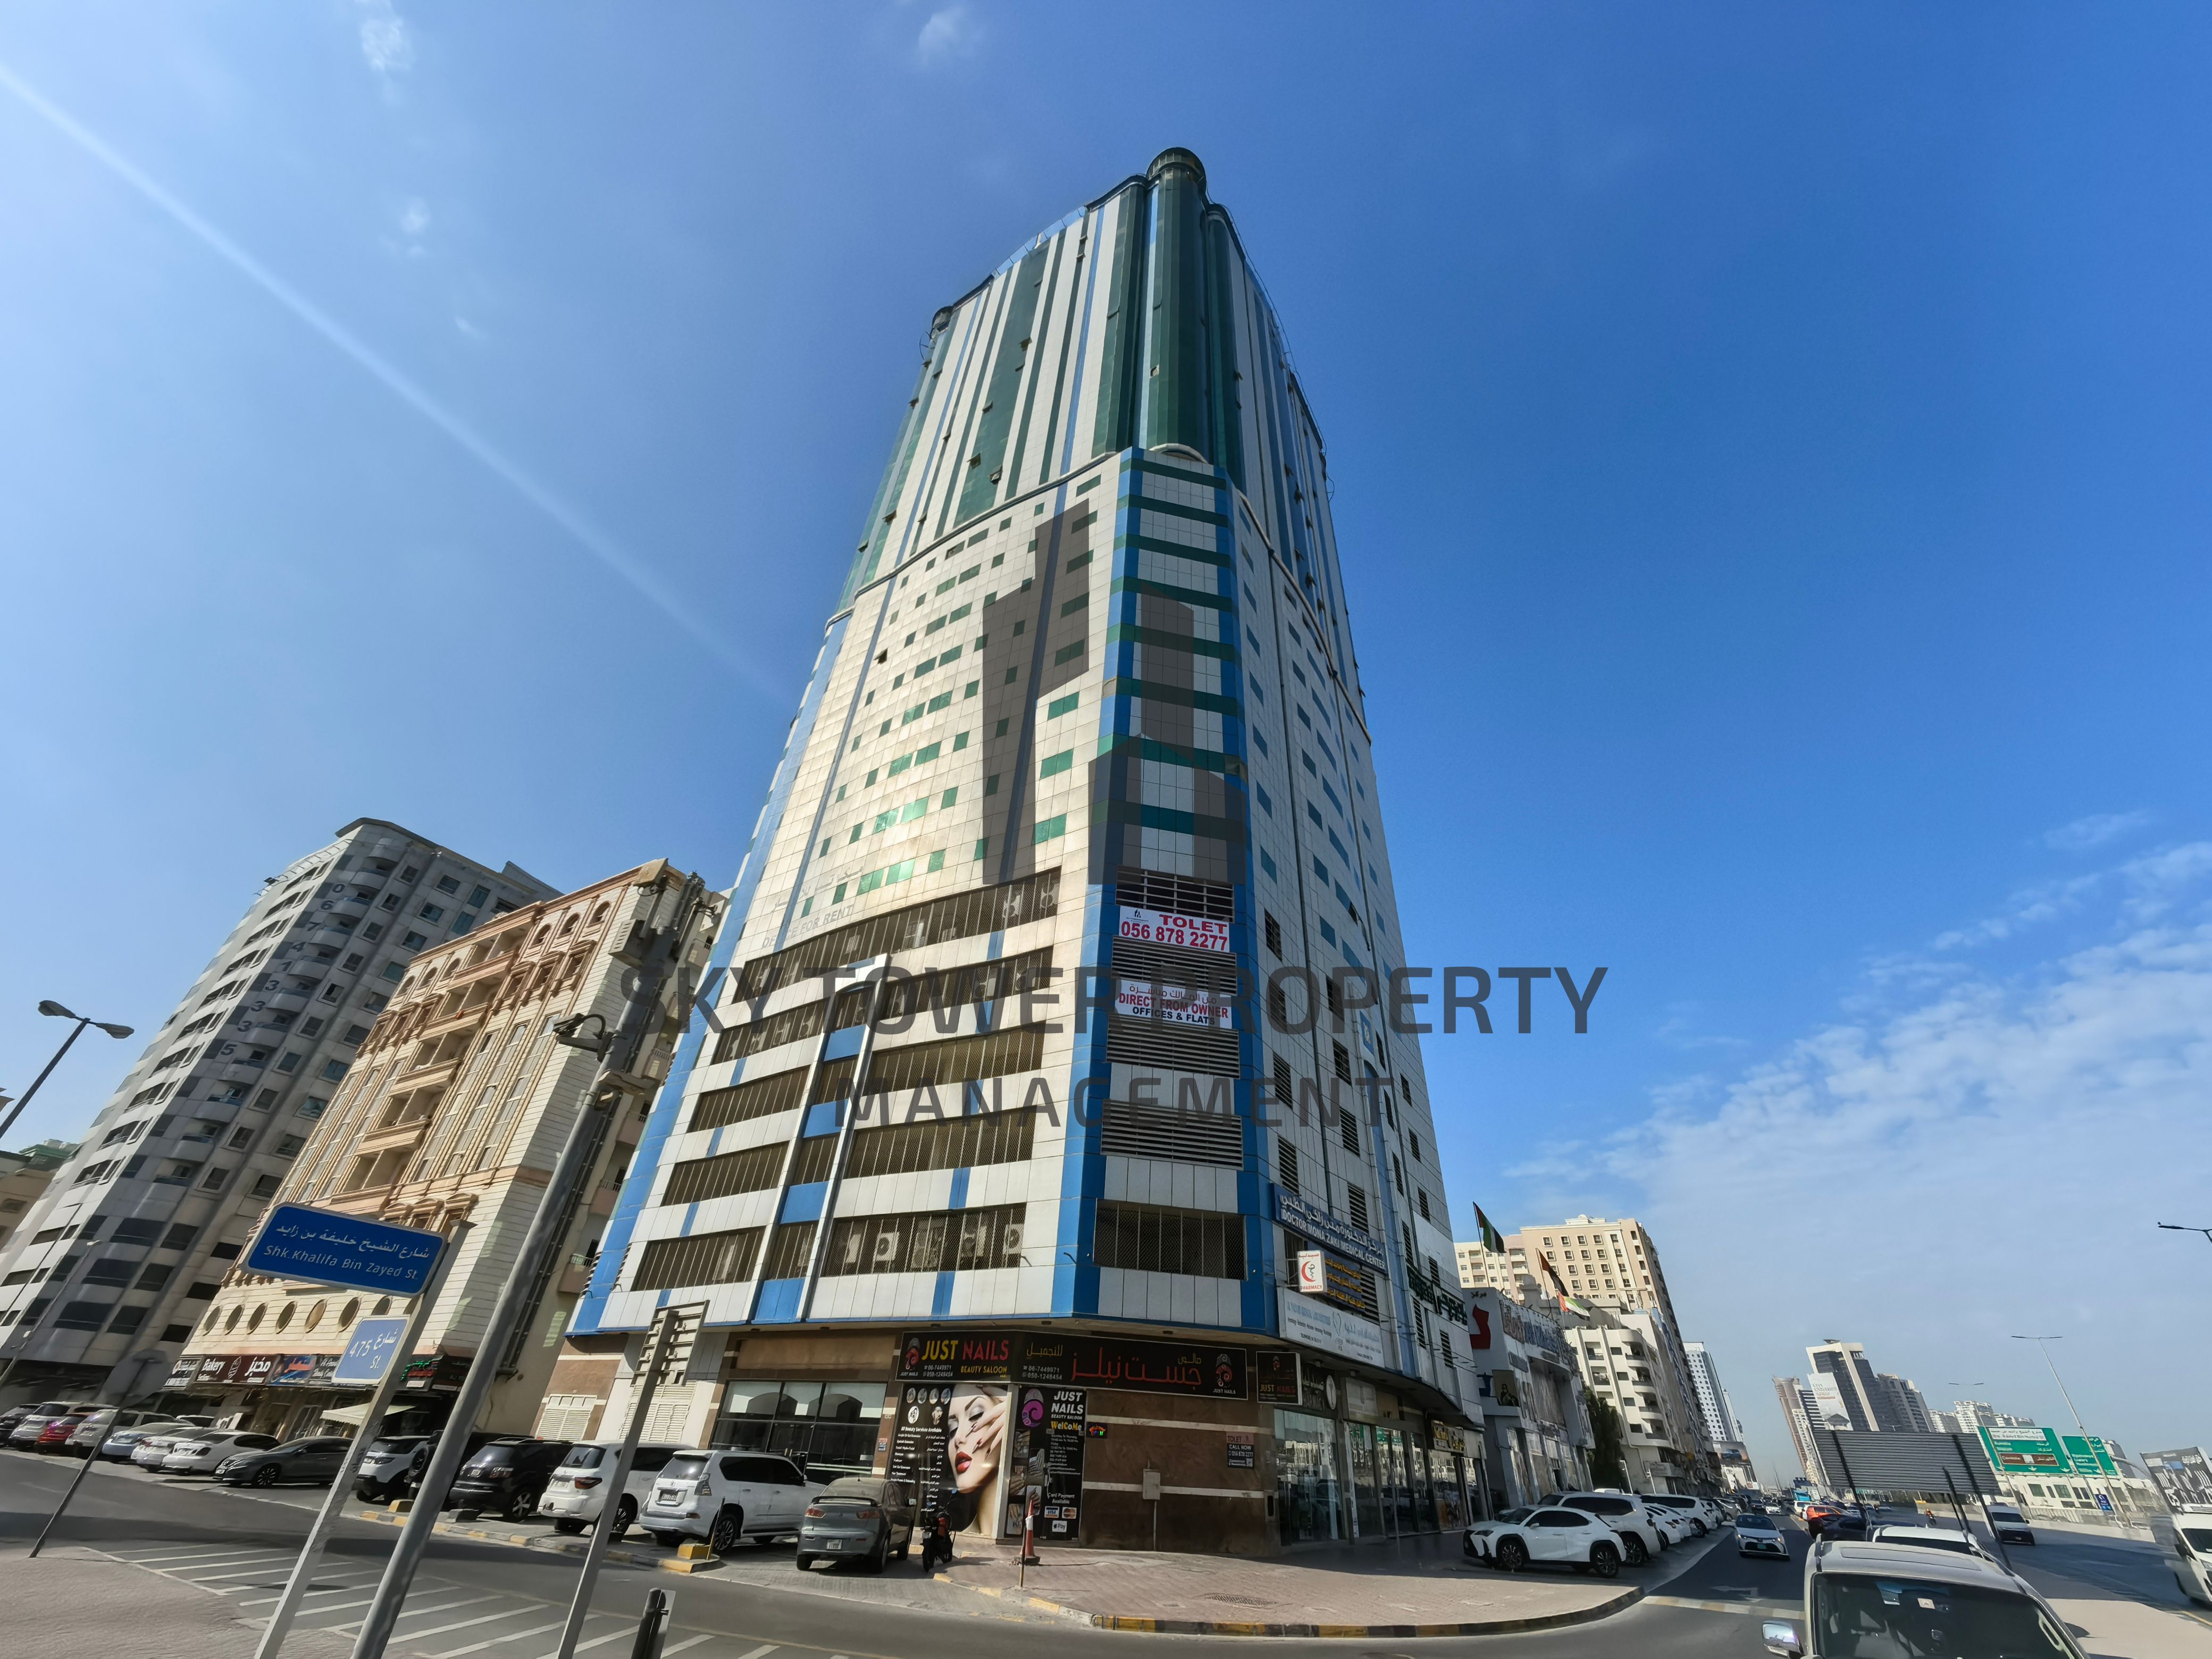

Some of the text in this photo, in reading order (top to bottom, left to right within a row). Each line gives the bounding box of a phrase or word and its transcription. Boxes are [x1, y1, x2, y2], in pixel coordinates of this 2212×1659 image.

[800, 916, 820, 934] FOR
[823, 904, 855, 924] RENT
[1159, 914, 1227, 934] TOLET
[1121, 921, 1228, 951] 056 878 2277
[1119, 993, 1228, 1018] DIRECT FROM OWNER
[1132, 1007, 1172, 1019] OFFICES
[1186, 1013, 1215, 1025] FLATS
[275, 1225, 430, 1259] شارع الشيخ خليفة بن زايد
[1281, 1209, 1307, 1232] DOCTOR
[1308, 1221, 1326, 1241] MONA
[1340, 1241, 1365, 1261] MEDICAL
[1365, 1253, 1386, 1270] CENTER
[342, 1259, 362, 1270] Bin
[366, 1262, 402, 1277] Zayed
[405, 1269, 418, 1280] St.
[349, 1338, 373, 1358] 475
[373, 1328, 398, 1351] شارع
[921, 1339, 1009, 1361] JUST NAILS
[201, 1358, 226, 1375] Bakery
[370, 1355, 381, 1369] St.
[1054, 1391, 1083, 1402] JUST
[1051, 1403, 1084, 1414] NAILS
